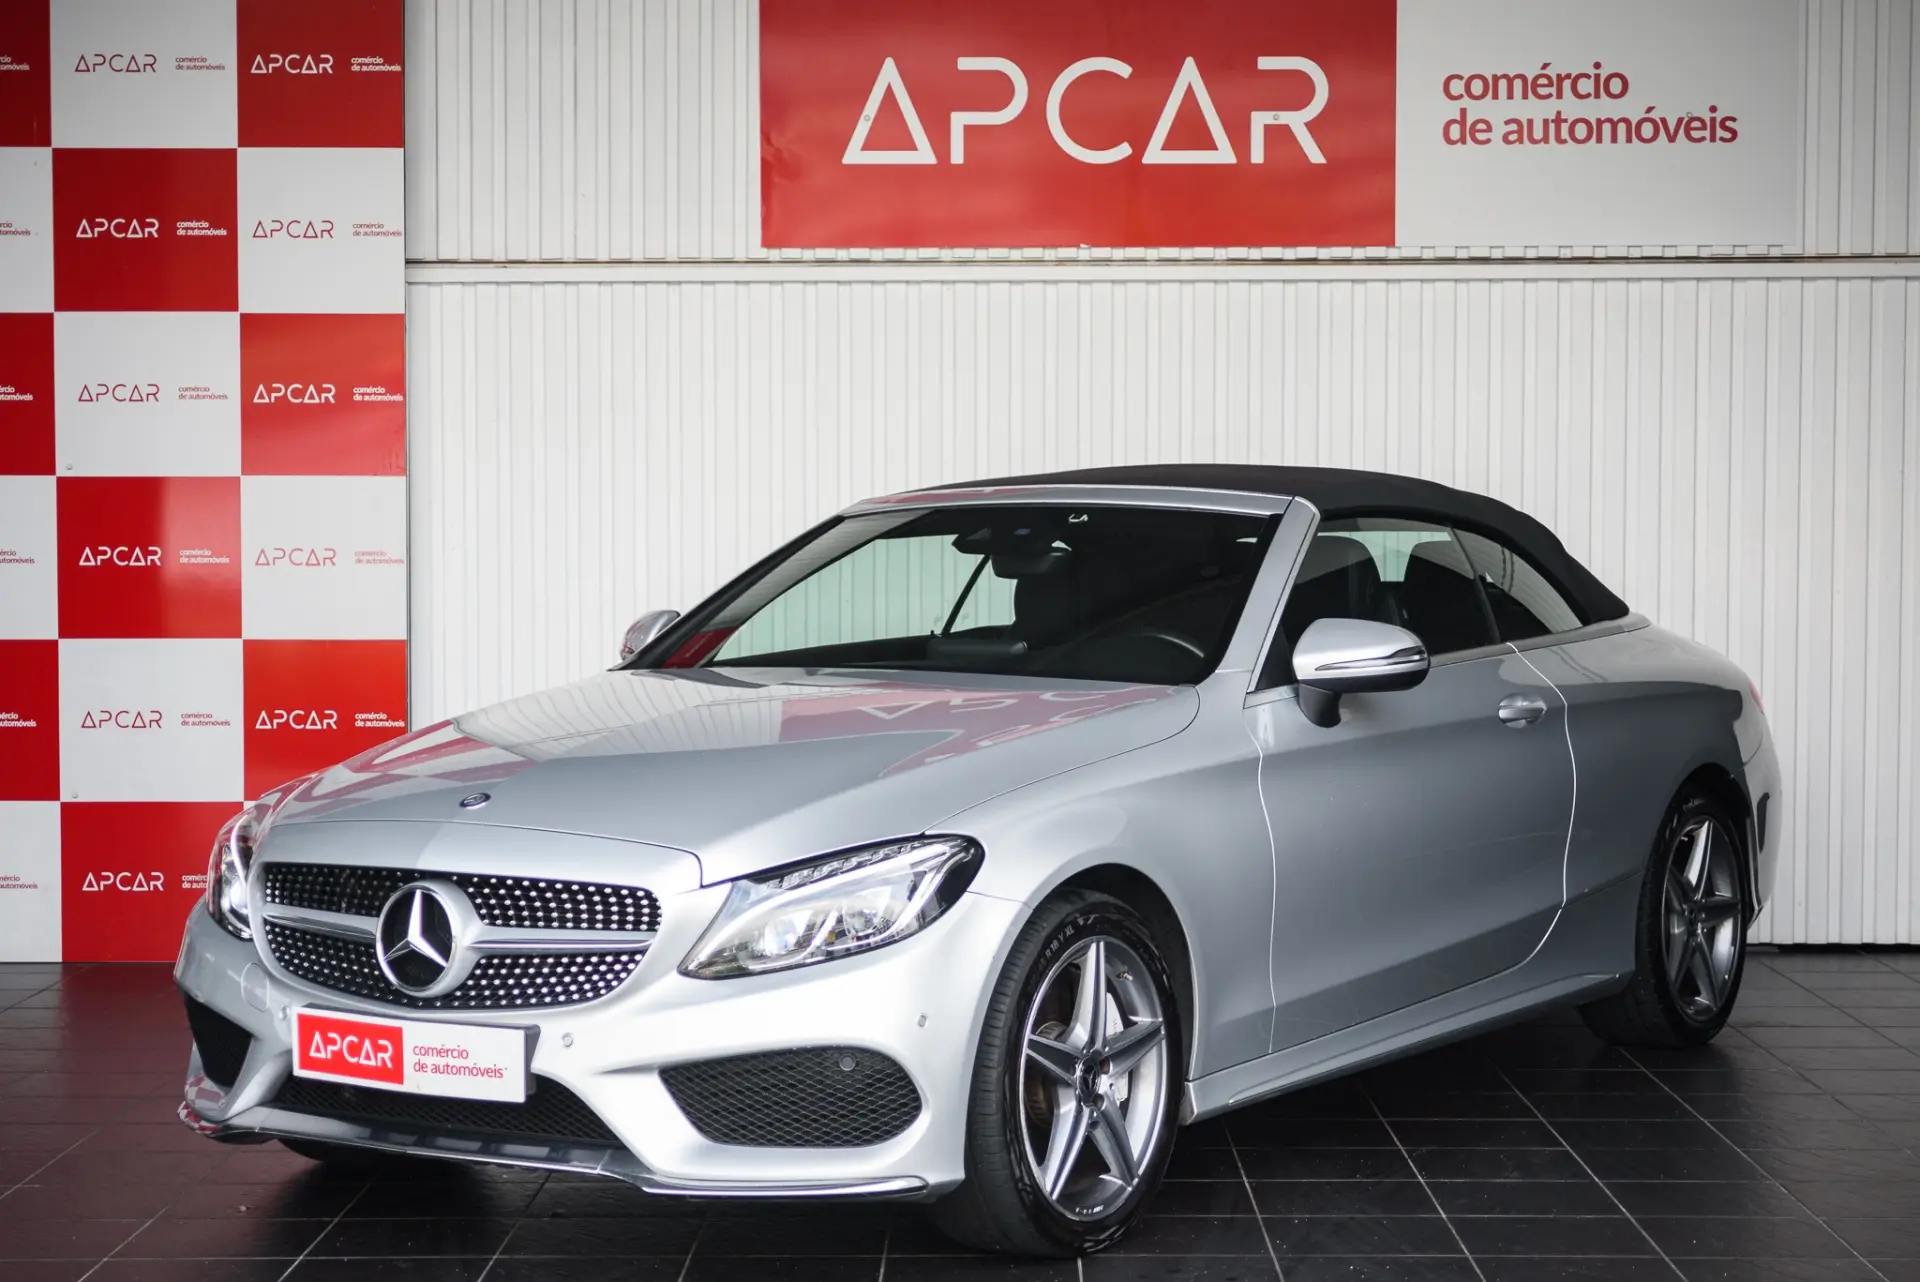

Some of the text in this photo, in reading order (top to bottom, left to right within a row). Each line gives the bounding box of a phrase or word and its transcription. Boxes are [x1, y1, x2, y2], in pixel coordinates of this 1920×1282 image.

[75, 54, 157, 73] APCAR
[250, 54, 334, 74] APCAR
[351, 56, 383, 64] comércio
[175, 63, 226, 71] de automóveis
[351, 63, 402, 72] de automóveis
[1443, 61, 1629, 101] comércio
[842, 57, 1328, 164] APCAR
[1442, 104, 1739, 146] de automóveis
[76, 218, 160, 239] APCAR
[177, 220, 208, 228] comércio
[352, 221, 384, 229] comércio
[177, 228, 227, 236] de automóveis
[252, 219, 334, 239] APCAR
[352, 229, 403, 237] de automóveis
[78, 384, 160, 402] APCAR
[178, 385, 210, 393] comércio
[253, 384, 336, 403] APCAR
[353, 386, 385, 394] comércio
[178, 392, 229, 400] de automóveis
[353, 393, 404, 402] de automóveis
[79, 547, 162, 566] APCAR
[179, 549, 211, 557] comércio
[255, 547, 337, 567] APCAR
[355, 549, 387, 557] comércio
[179, 556, 230, 564] de automóveis
[355, 557, 405, 565] de automóveis
[81, 710, 163, 729] APCAR
[255, 710, 338, 730] APCAR
[355, 712, 388, 720] comércio
[181, 719, 231, 727] de automóveis
[355, 719, 405, 728] de automóveis
[82, 871, 165, 892] APCAR
[182, 881, 191, 889] de
[309, 1031, 393, 1068] APCAR
[413, 1044, 470, 1060] comércio
[413, 1058, 504, 1079] de automóveis
